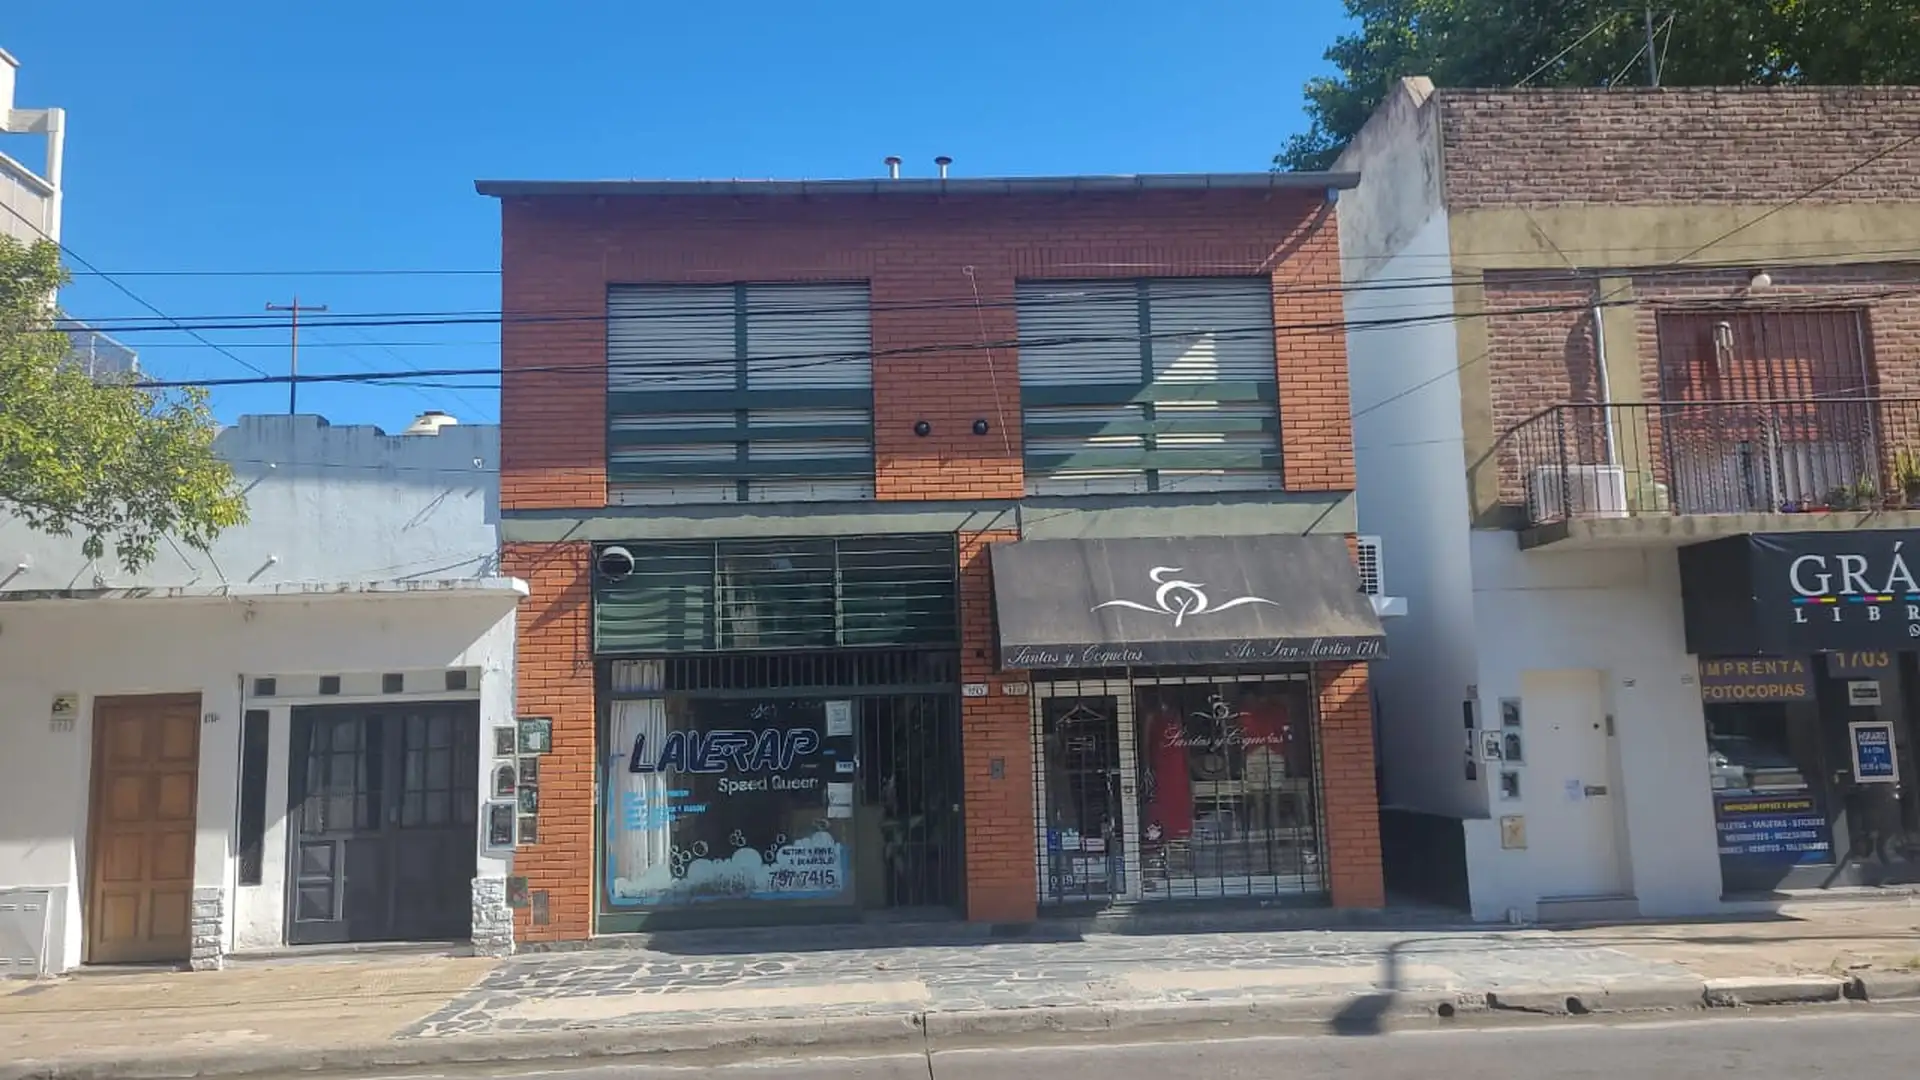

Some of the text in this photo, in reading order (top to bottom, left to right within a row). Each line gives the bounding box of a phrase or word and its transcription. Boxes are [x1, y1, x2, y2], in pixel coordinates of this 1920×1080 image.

[1082, 644, 1142, 667] Coquetas
[1702, 683, 1805, 699] FOTOCOPIAS
[718, 774, 819, 796] Speed Queen
